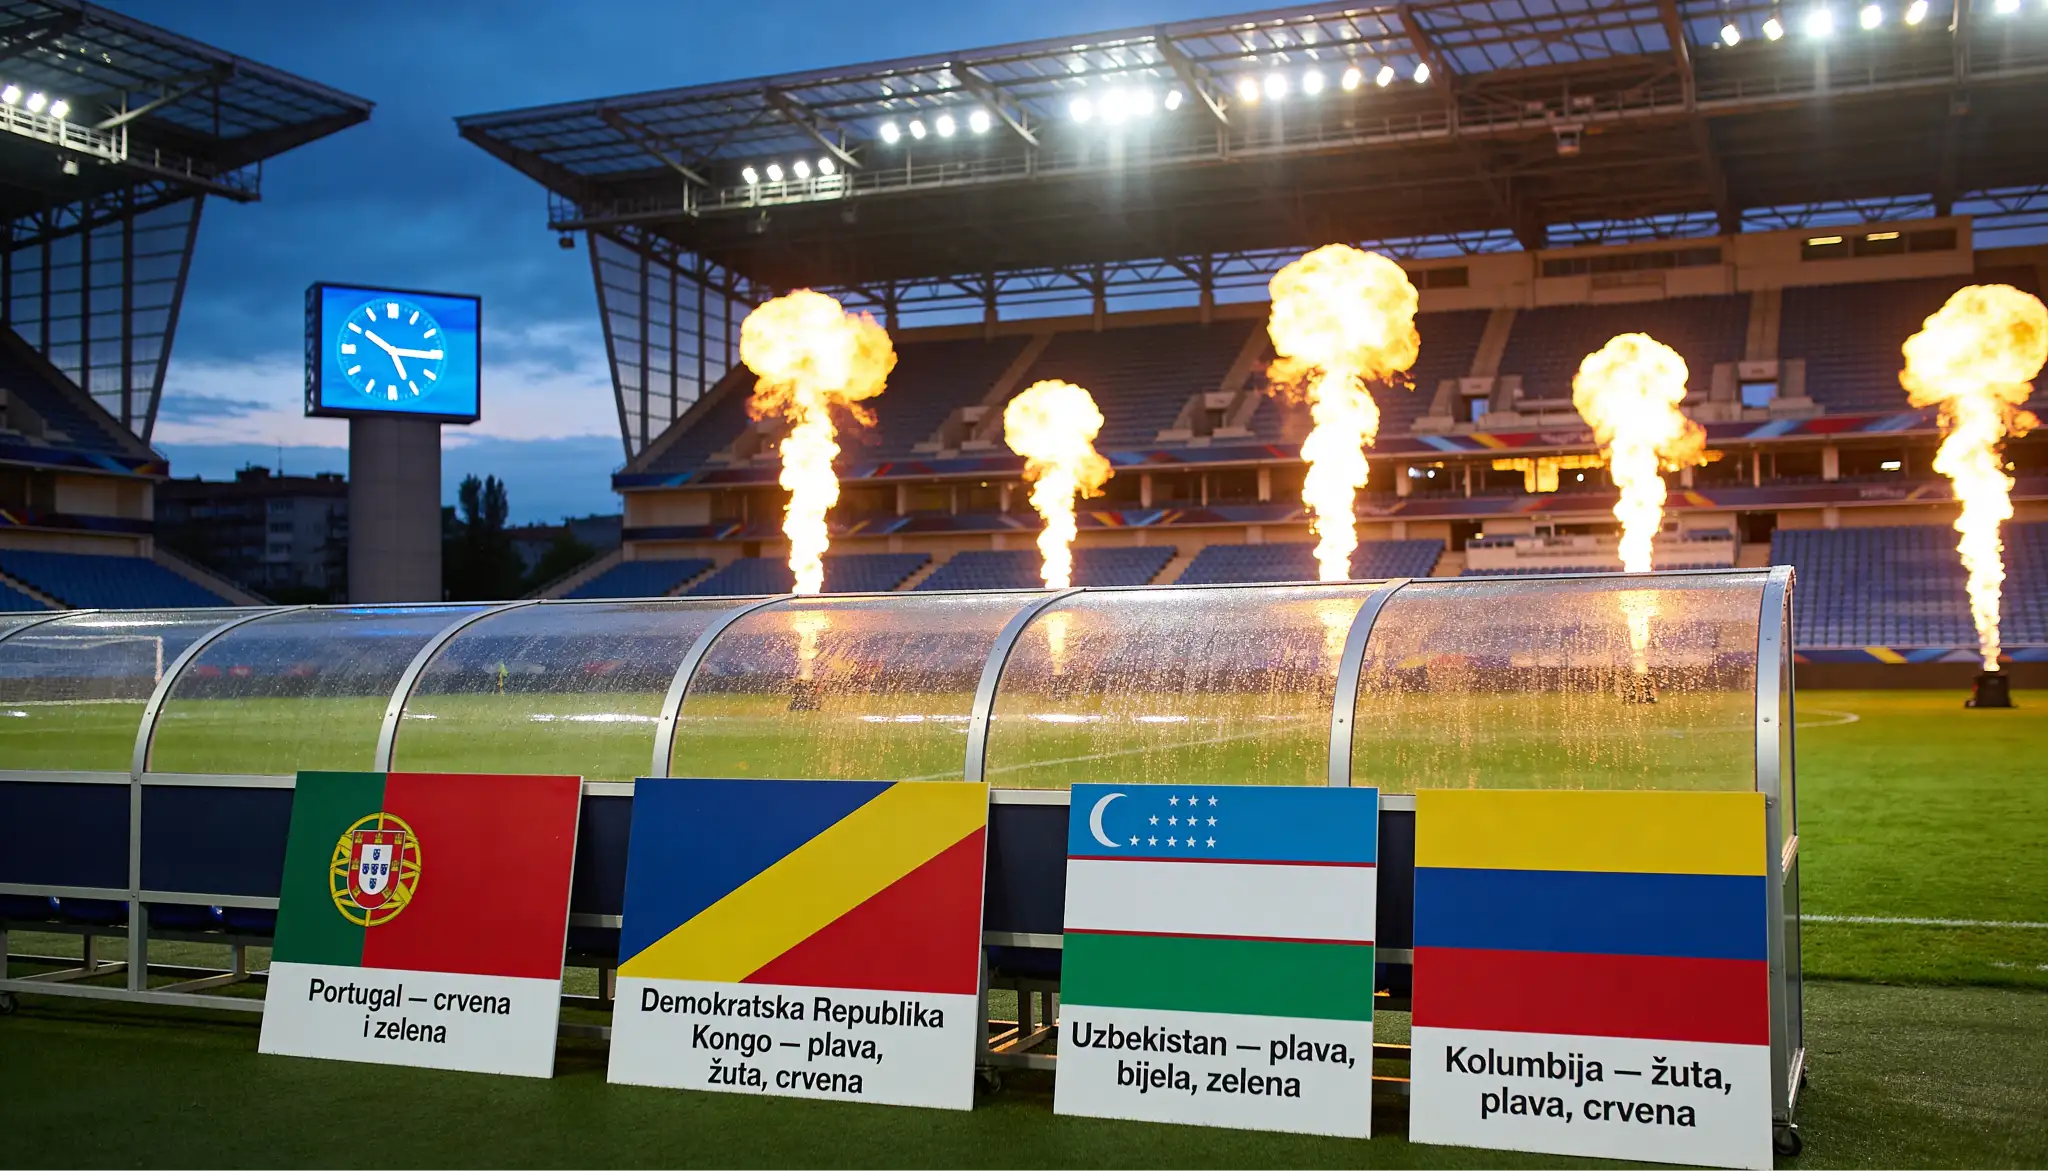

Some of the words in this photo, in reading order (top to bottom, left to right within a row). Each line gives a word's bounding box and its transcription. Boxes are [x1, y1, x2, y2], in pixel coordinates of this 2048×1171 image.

[308, 977, 403, 1012] Portugal
[433, 992, 511, 1015] crvena
[640, 987, 804, 1022] Demokratska
[813, 996, 944, 1029] Republika
[363, 1013, 370, 1038] i
[373, 1016, 447, 1044] zelena
[692, 1023, 772, 1062] Kongo
[807, 1030, 883, 1065] plava,
[1072, 1021, 1227, 1057] Uzbekistan
[1269, 1033, 1356, 1070] plava,
[707, 1057, 768, 1090] žuta,
[775, 1069, 863, 1094] crvena
[1117, 1059, 1198, 1094] bijela,
[1206, 1067, 1301, 1099] zelena
[1446, 1045, 1604, 1088] Kolumbija
[1651, 1055, 1732, 1096] žuta,
[1481, 1086, 1573, 1124] plava,
[1583, 1099, 1696, 1128] crvena
